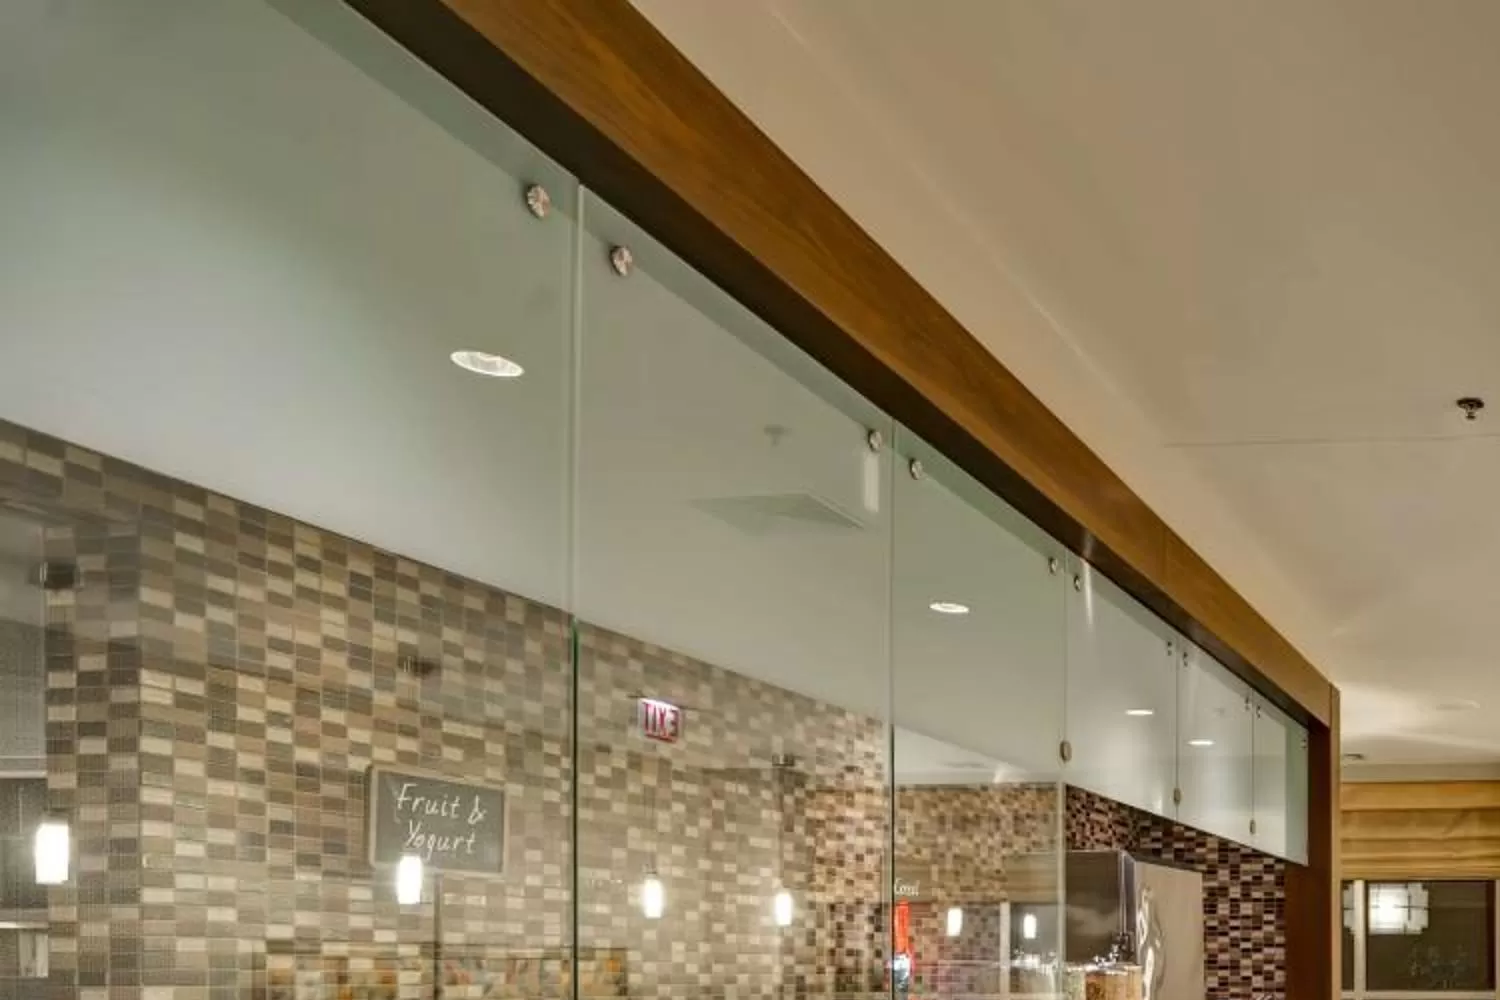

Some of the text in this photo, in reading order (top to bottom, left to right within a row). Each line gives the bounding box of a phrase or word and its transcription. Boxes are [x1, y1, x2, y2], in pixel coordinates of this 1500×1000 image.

[397, 783, 487, 825] Fruit &
[405, 819, 475, 861] Yogurt
